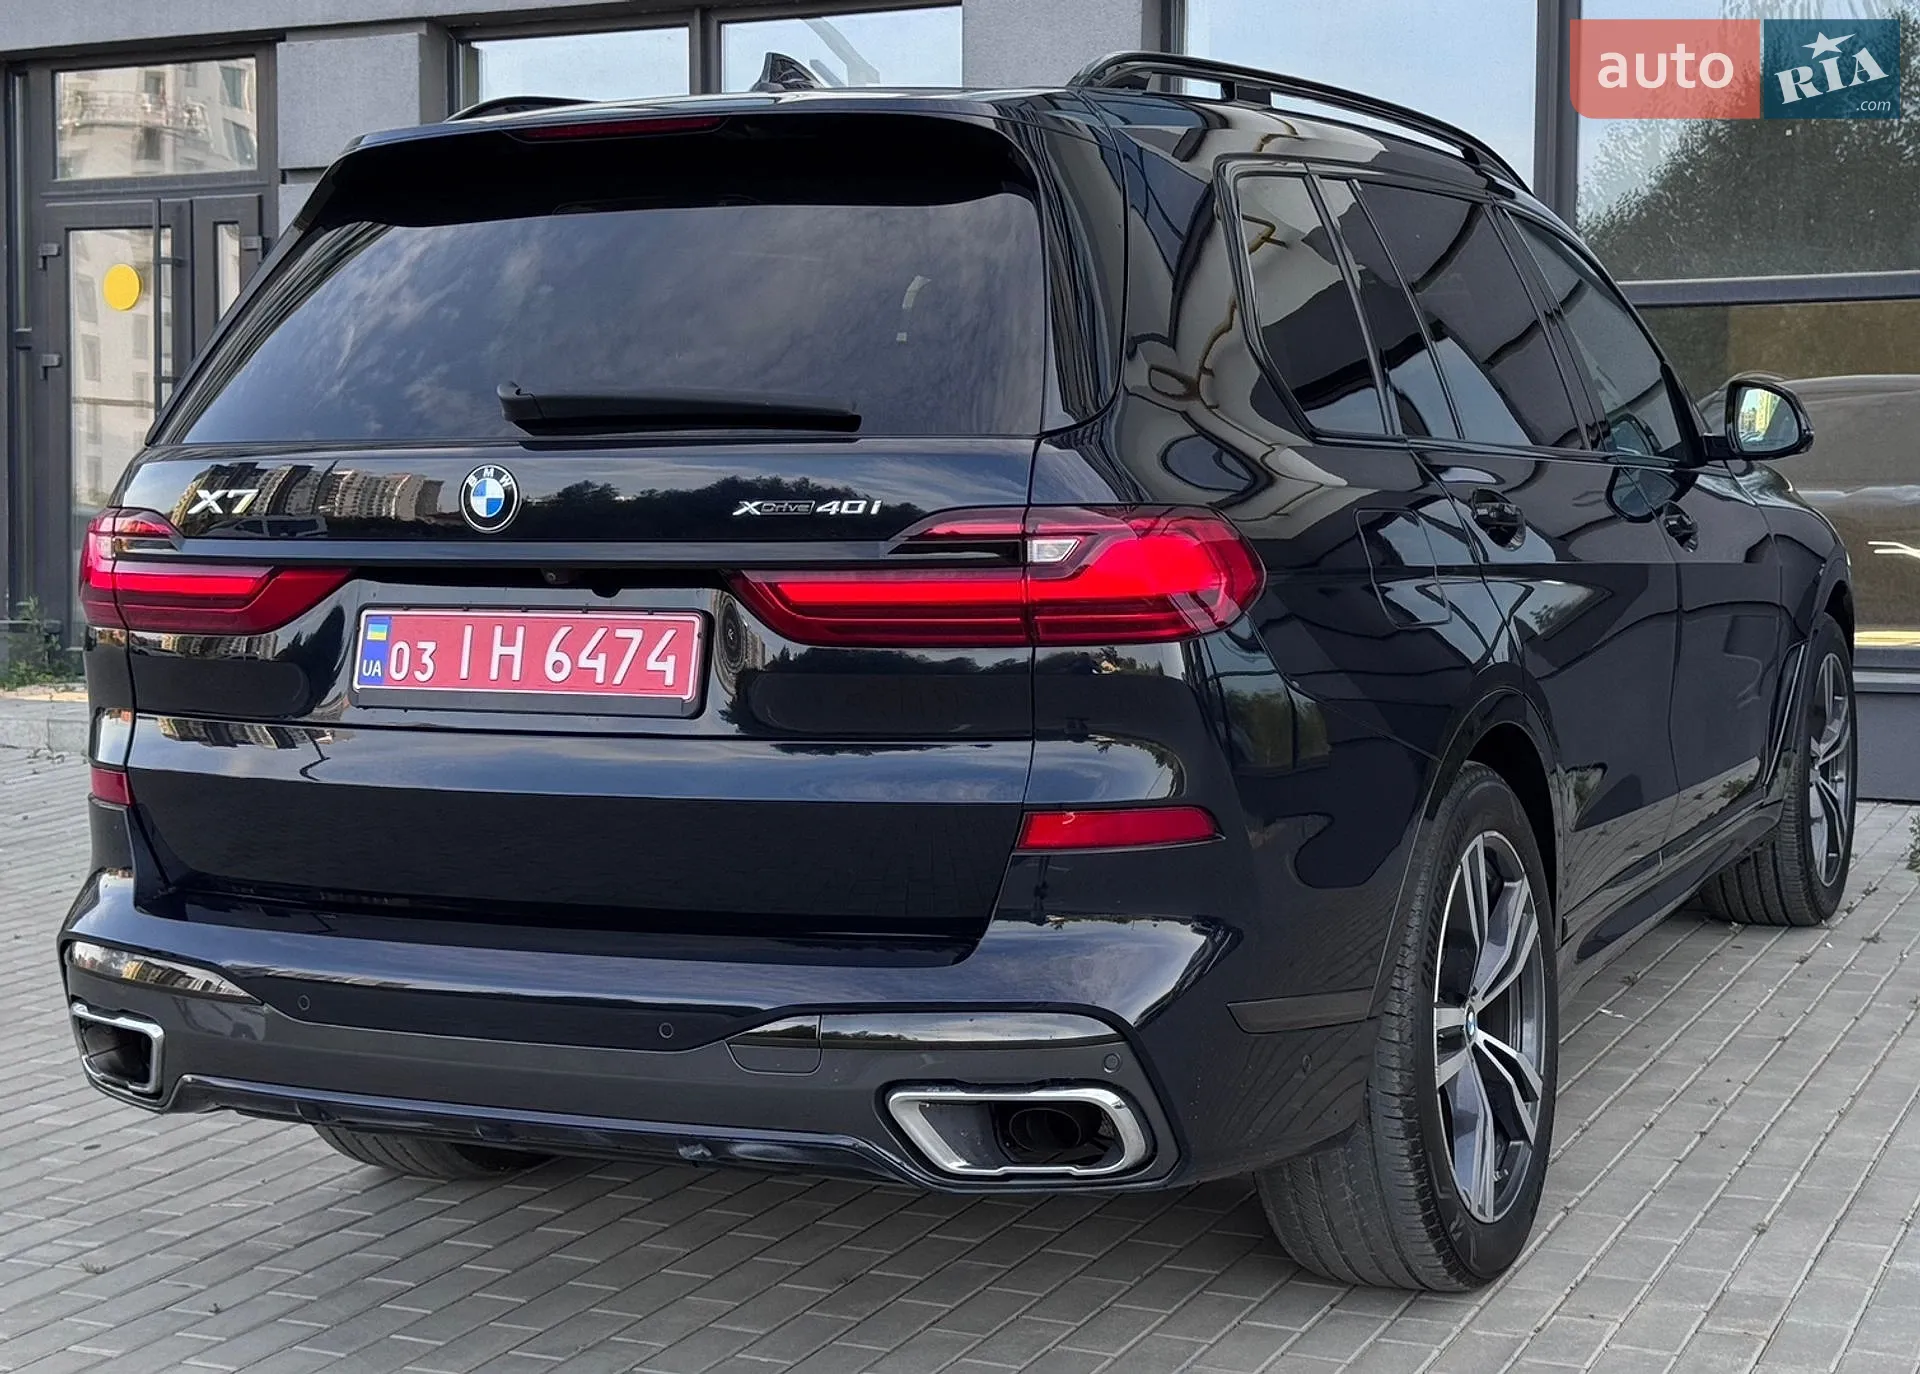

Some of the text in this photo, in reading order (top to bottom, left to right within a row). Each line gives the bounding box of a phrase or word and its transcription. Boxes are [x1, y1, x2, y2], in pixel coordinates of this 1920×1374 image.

[467, 467, 512, 488] BMW
[187, 488, 259, 514] X7
[388, 640, 437, 683] 03
[544, 625, 678, 687] 6474
[362, 659, 382, 677] UA
